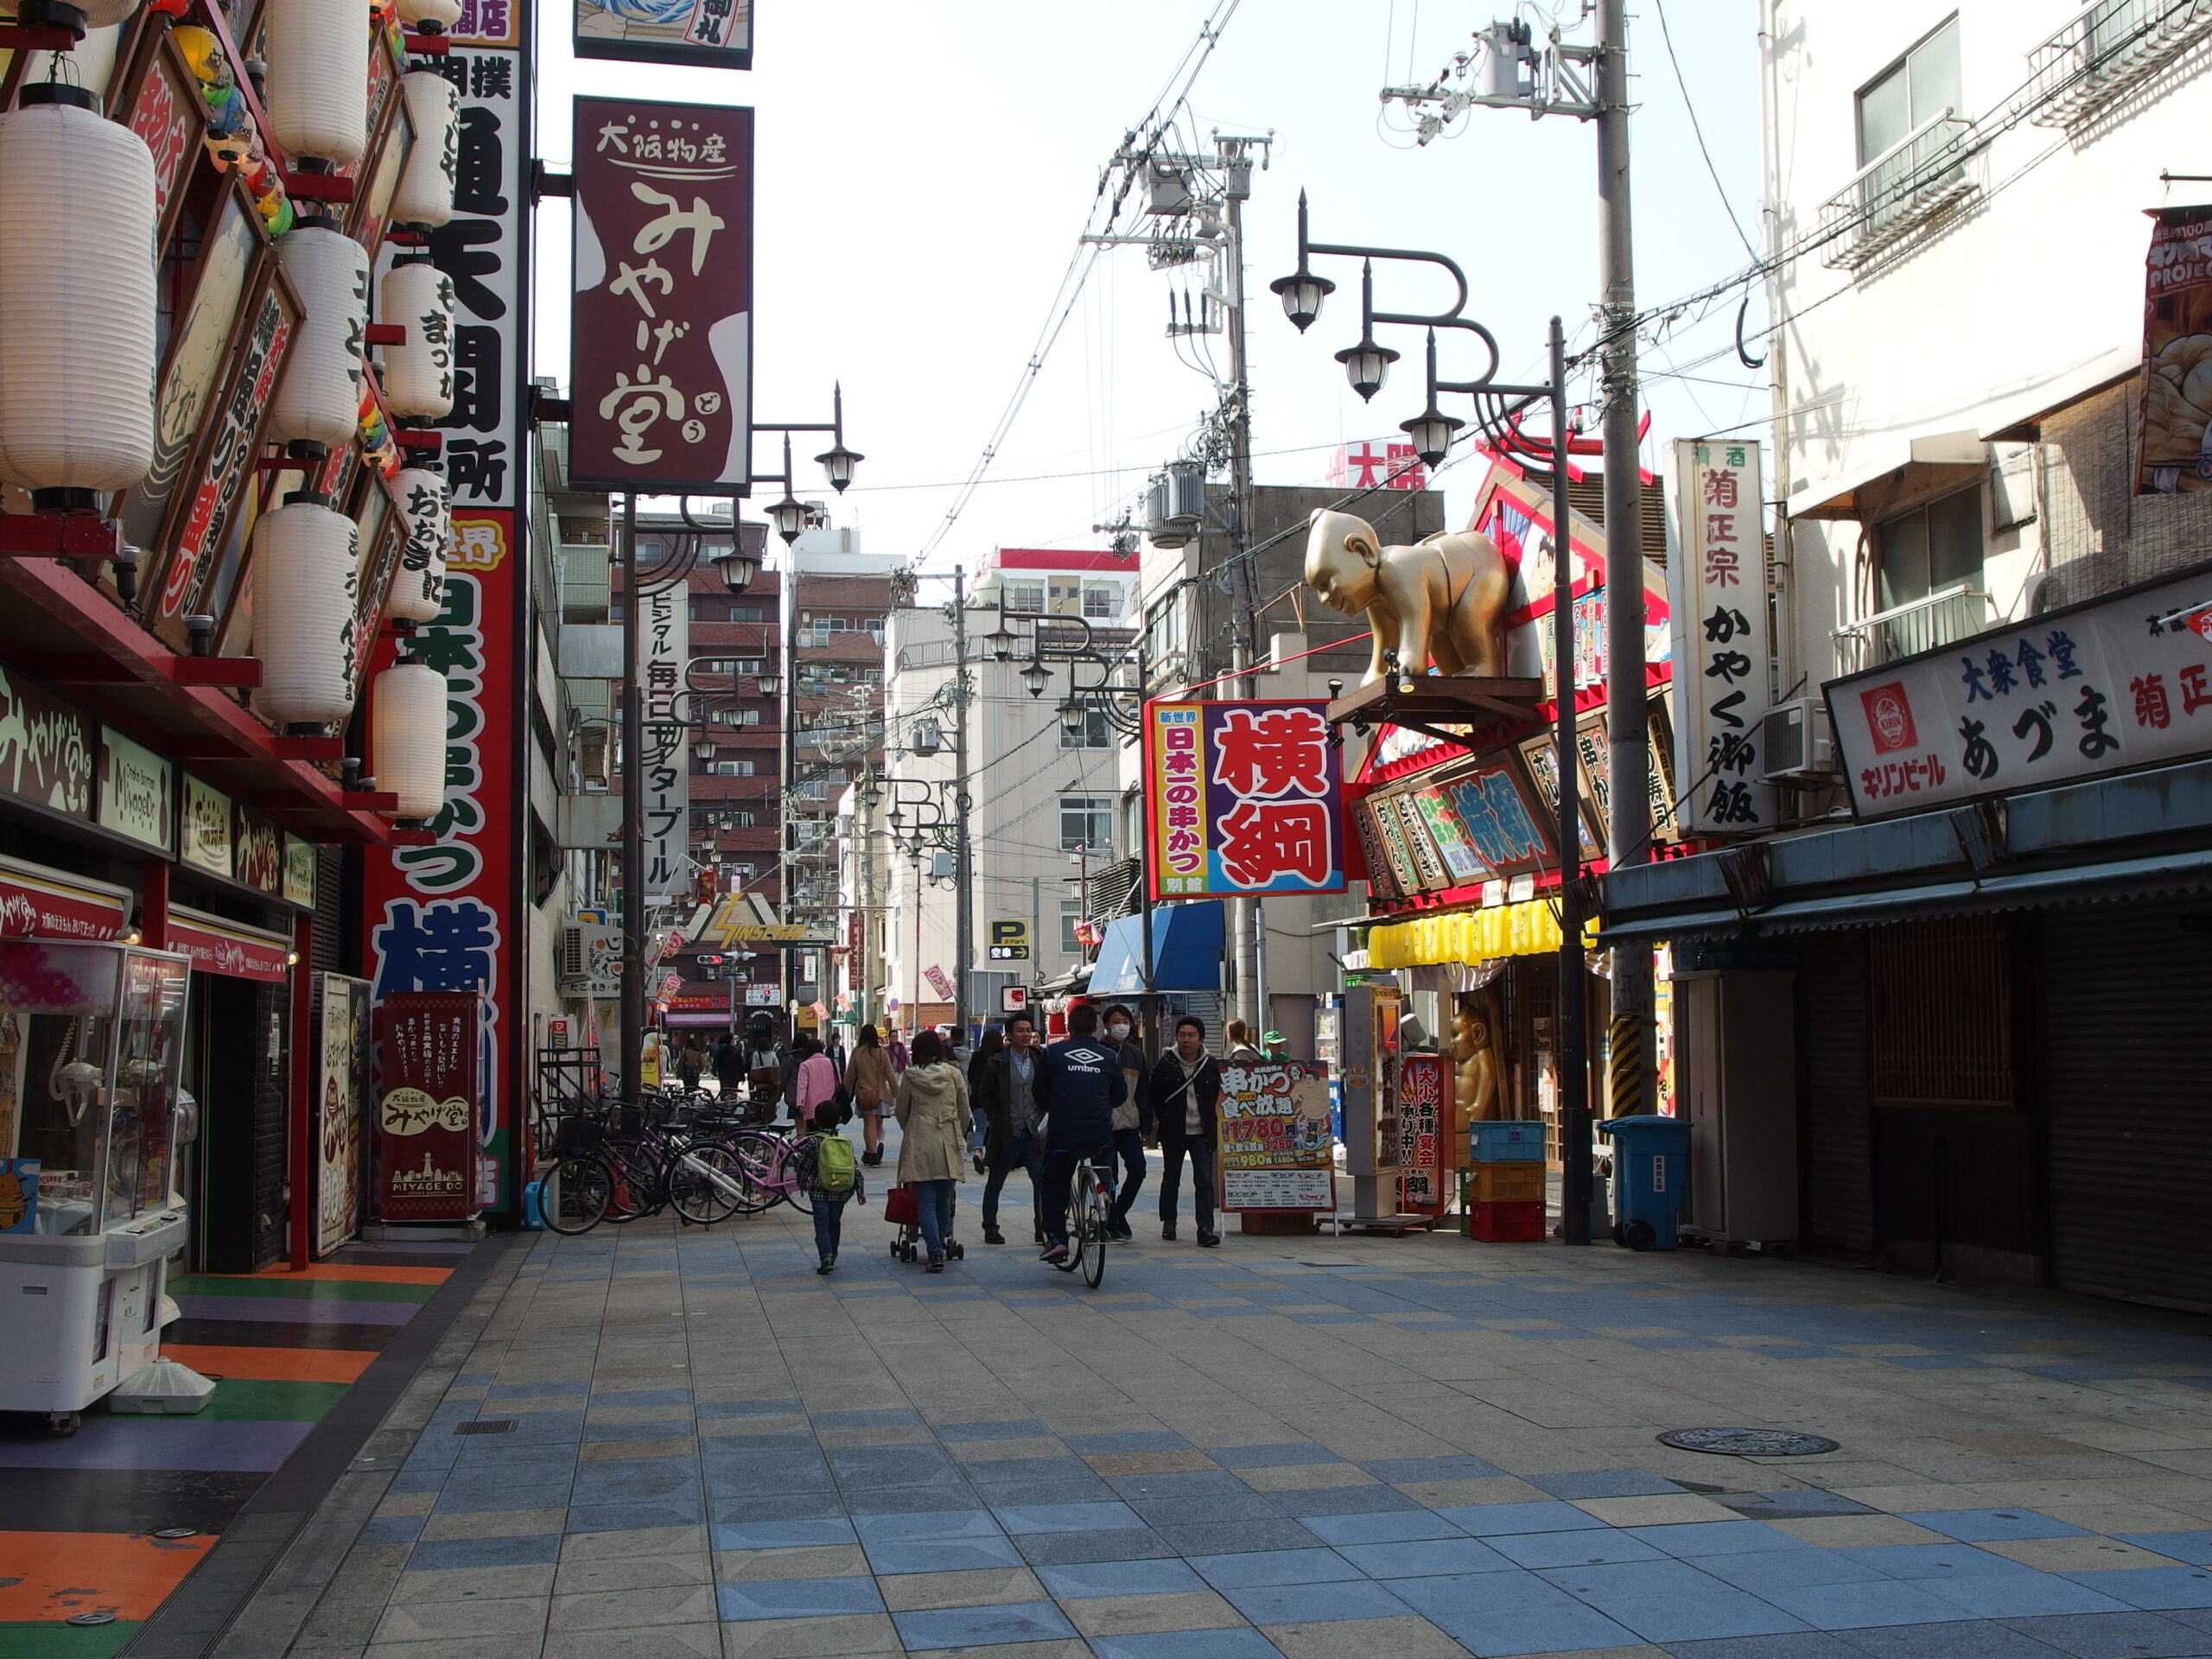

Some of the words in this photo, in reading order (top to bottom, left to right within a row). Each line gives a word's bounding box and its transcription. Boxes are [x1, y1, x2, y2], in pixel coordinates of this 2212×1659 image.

[597, 122, 727, 163] 大阪物産
[600, 181, 724, 465] みやげ堂
[1691, 446, 1745, 467] 清酒
[1703, 469, 1739, 588] 菊正宗
[1961, 630, 2082, 702] 大衆食堂
[1160, 710, 1198, 724] 新世界
[1703, 605, 1759, 823] かやく御飯
[1961, 685, 2120, 780] あづま
[1860, 753, 1946, 800] キリンビール
[1164, 727, 1203, 876] 日本一の串かつ
[1216, 710, 1329, 887] 横綱
[1166, 877, 1204, 893] 別館
[990, 947, 1012, 958] 空車
[1067, 1064, 1101, 1074] umbro
[1219, 1066, 1290, 1096] 串かつ
[385, 1103, 464, 1133] みやげ堂
[1220, 1093, 1294, 1118] 食べ放題
[1417, 1068, 1436, 1166] 大小各種宴会
[392, 1182, 442, 1192] MIYAGE
[446, 1182, 463, 1192] DO
